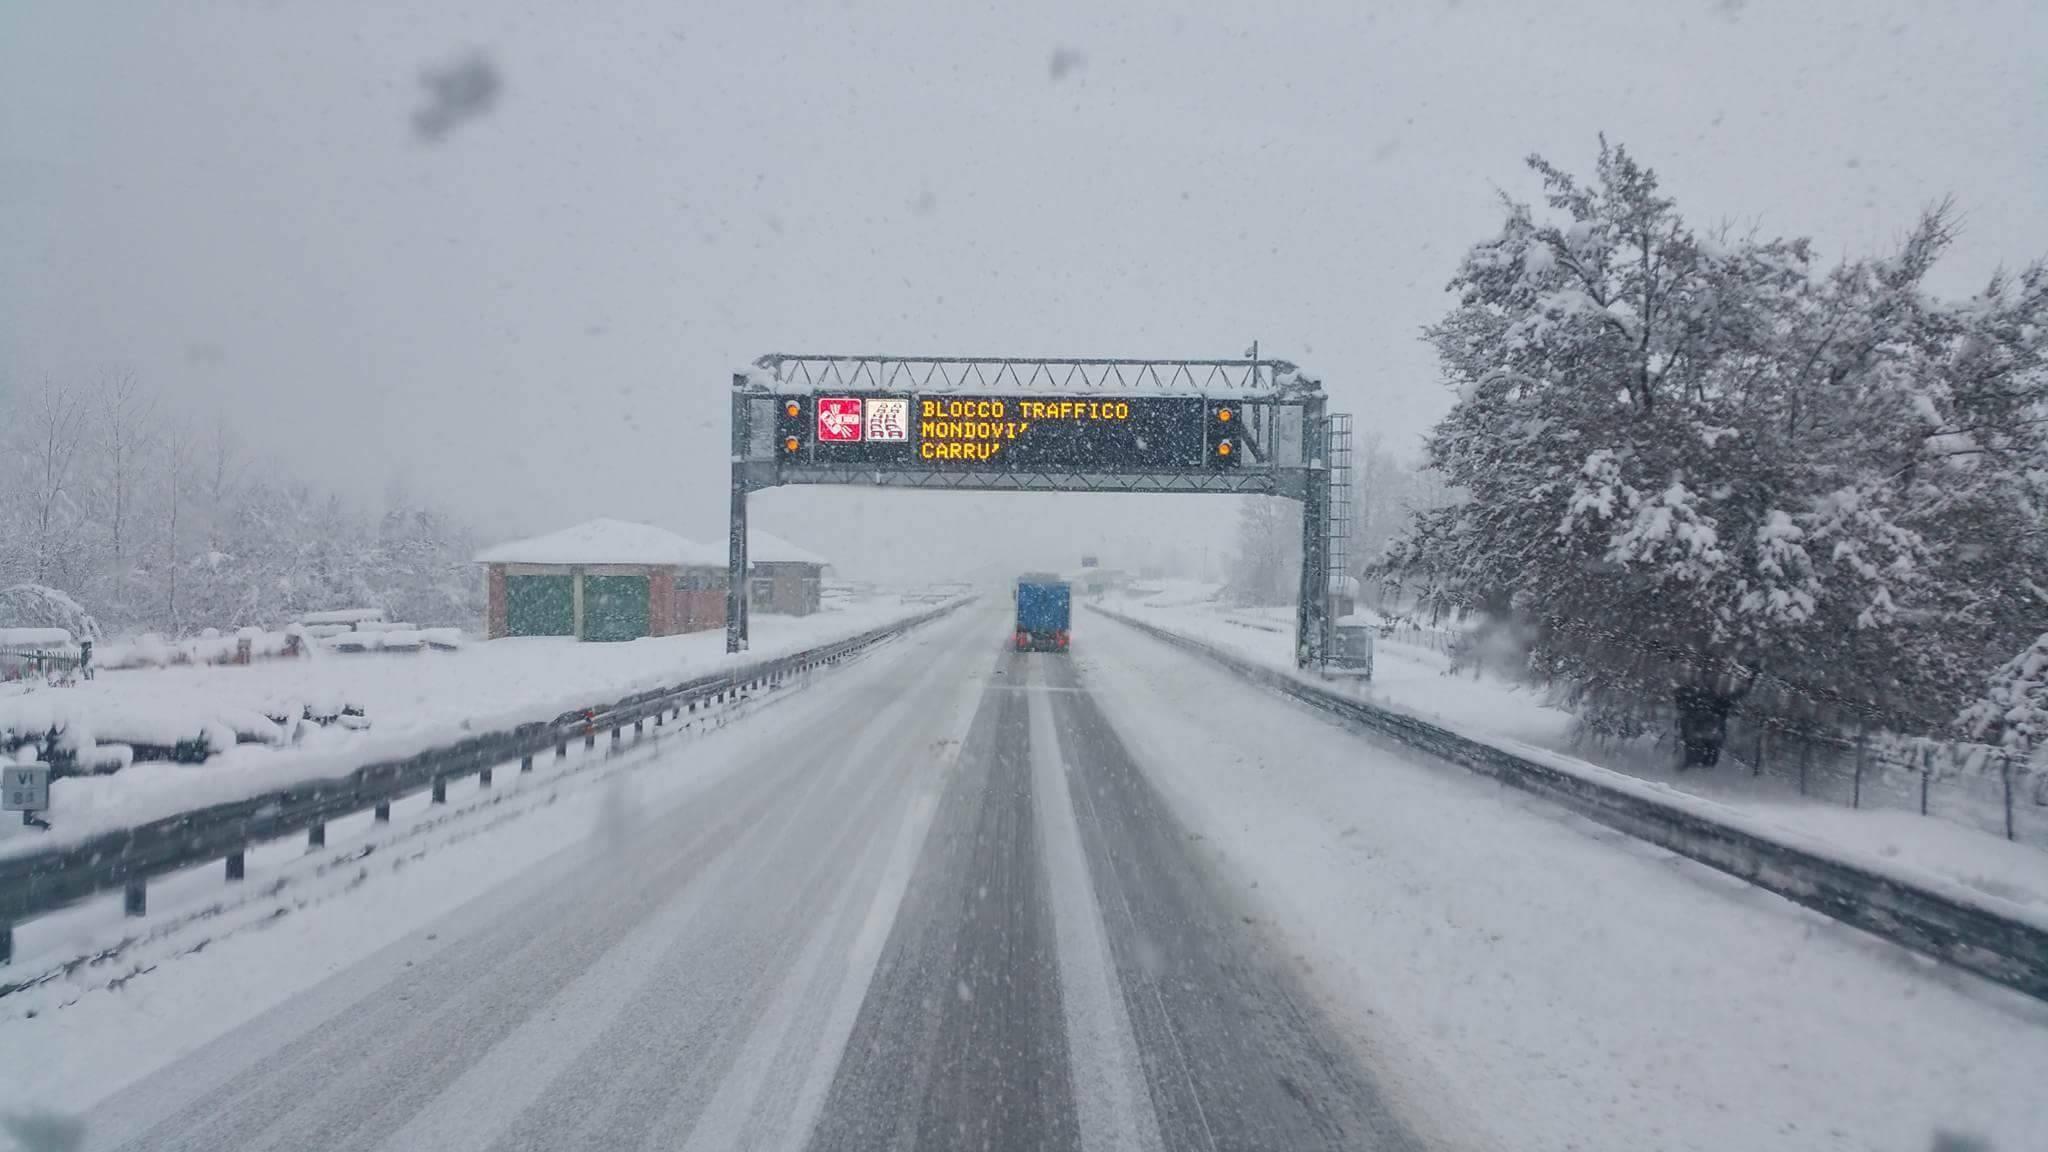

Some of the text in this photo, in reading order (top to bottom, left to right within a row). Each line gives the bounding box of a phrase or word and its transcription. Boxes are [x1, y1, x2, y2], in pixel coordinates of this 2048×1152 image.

[922, 401, 1129, 419] BLOCCO TRAFFICO
[921, 421, 1028, 439] MONDOVI'
[921, 441, 1000, 459] CARRU'
